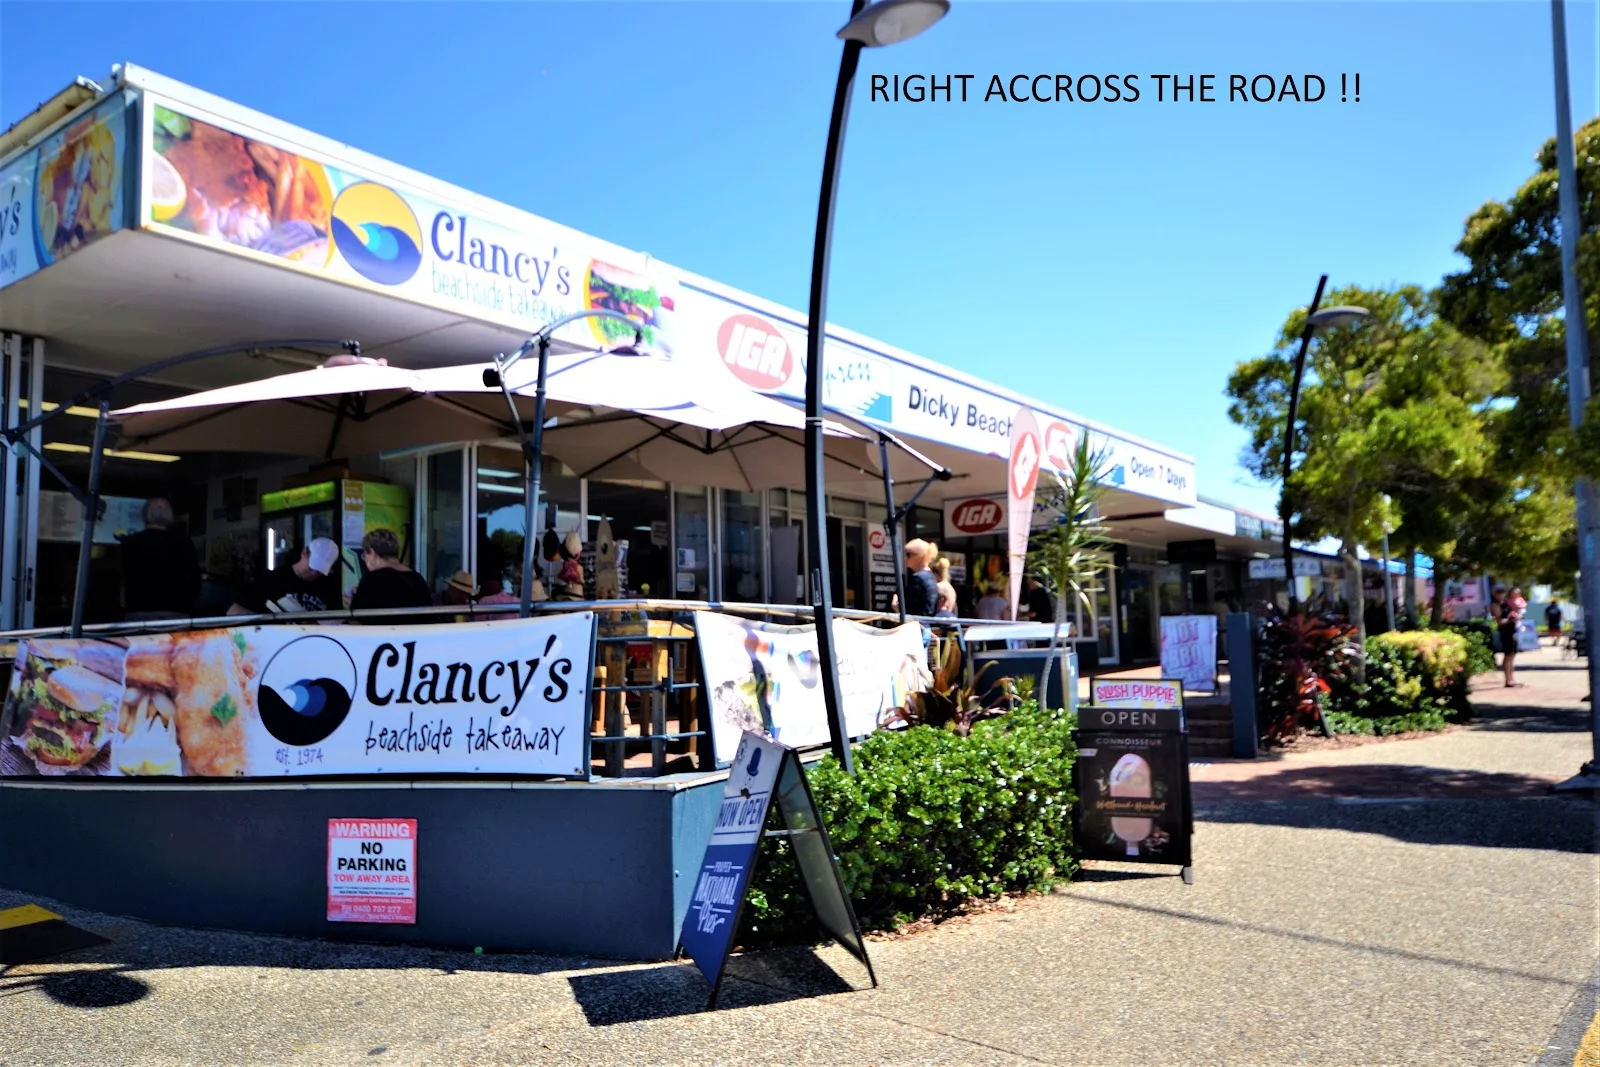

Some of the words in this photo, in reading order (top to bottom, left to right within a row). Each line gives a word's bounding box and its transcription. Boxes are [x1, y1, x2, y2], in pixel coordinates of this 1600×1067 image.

[431, 211, 570, 296] Clancy's
[432, 260, 503, 310] beachside
[725, 322, 787, 378] IGA
[908, 384, 959, 427] Dicky
[1131, 456, 1155, 479] Open
[1159, 464, 1164, 480] 7
[957, 504, 996, 527] IGA
[366, 634, 572, 717] Clancy's
[1096, 684, 1130, 700] SLUSH
[1132, 684, 1177, 703] PUPPIE
[1101, 711, 1157, 725] OPEN
[365, 712, 452, 755] beachside
[466, 717, 565, 755] takeaway
[1096, 737, 1162, 746] CONNOISSEUR
[297, 747, 324, 765] 1974
[716, 801, 741, 828] NOW
[738, 798, 768, 827] OPEN
[335, 823, 410, 837] WARNING
[361, 842, 383, 855] NO
[338, 858, 406, 871] PARKING
[334, 874, 354, 882] TOW
[357, 874, 382, 883] AWAY
[385, 875, 410, 884] AREA
[695, 872, 740, 905] NATIONAL
